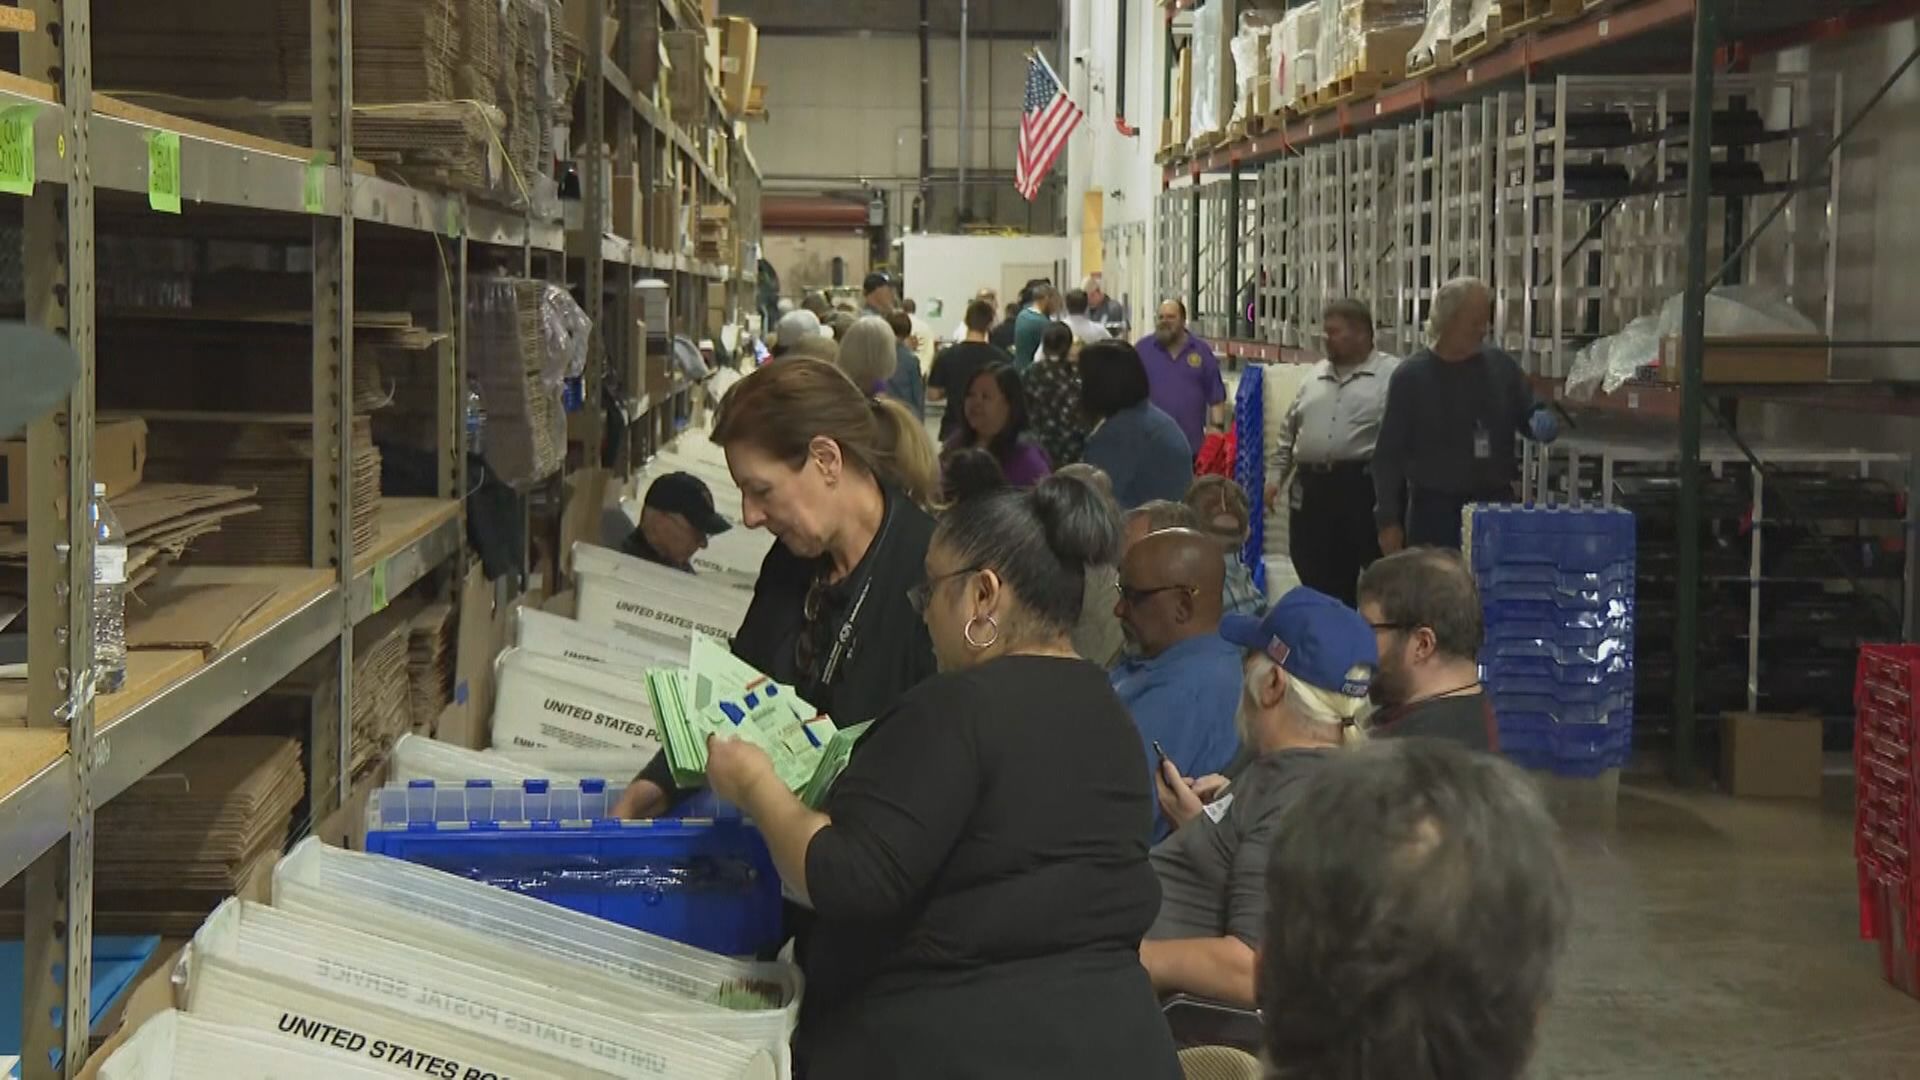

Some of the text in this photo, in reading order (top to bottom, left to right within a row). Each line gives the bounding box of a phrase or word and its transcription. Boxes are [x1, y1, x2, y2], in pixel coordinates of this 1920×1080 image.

[616, 600, 654, 618] UNITED
[656, 611, 694, 630] STATES
[543, 698, 593, 721] UNITED
[594, 713, 645, 737] STATES
[277, 1013, 367, 1052] UNITED
[369, 1040, 459, 1080] STATES
